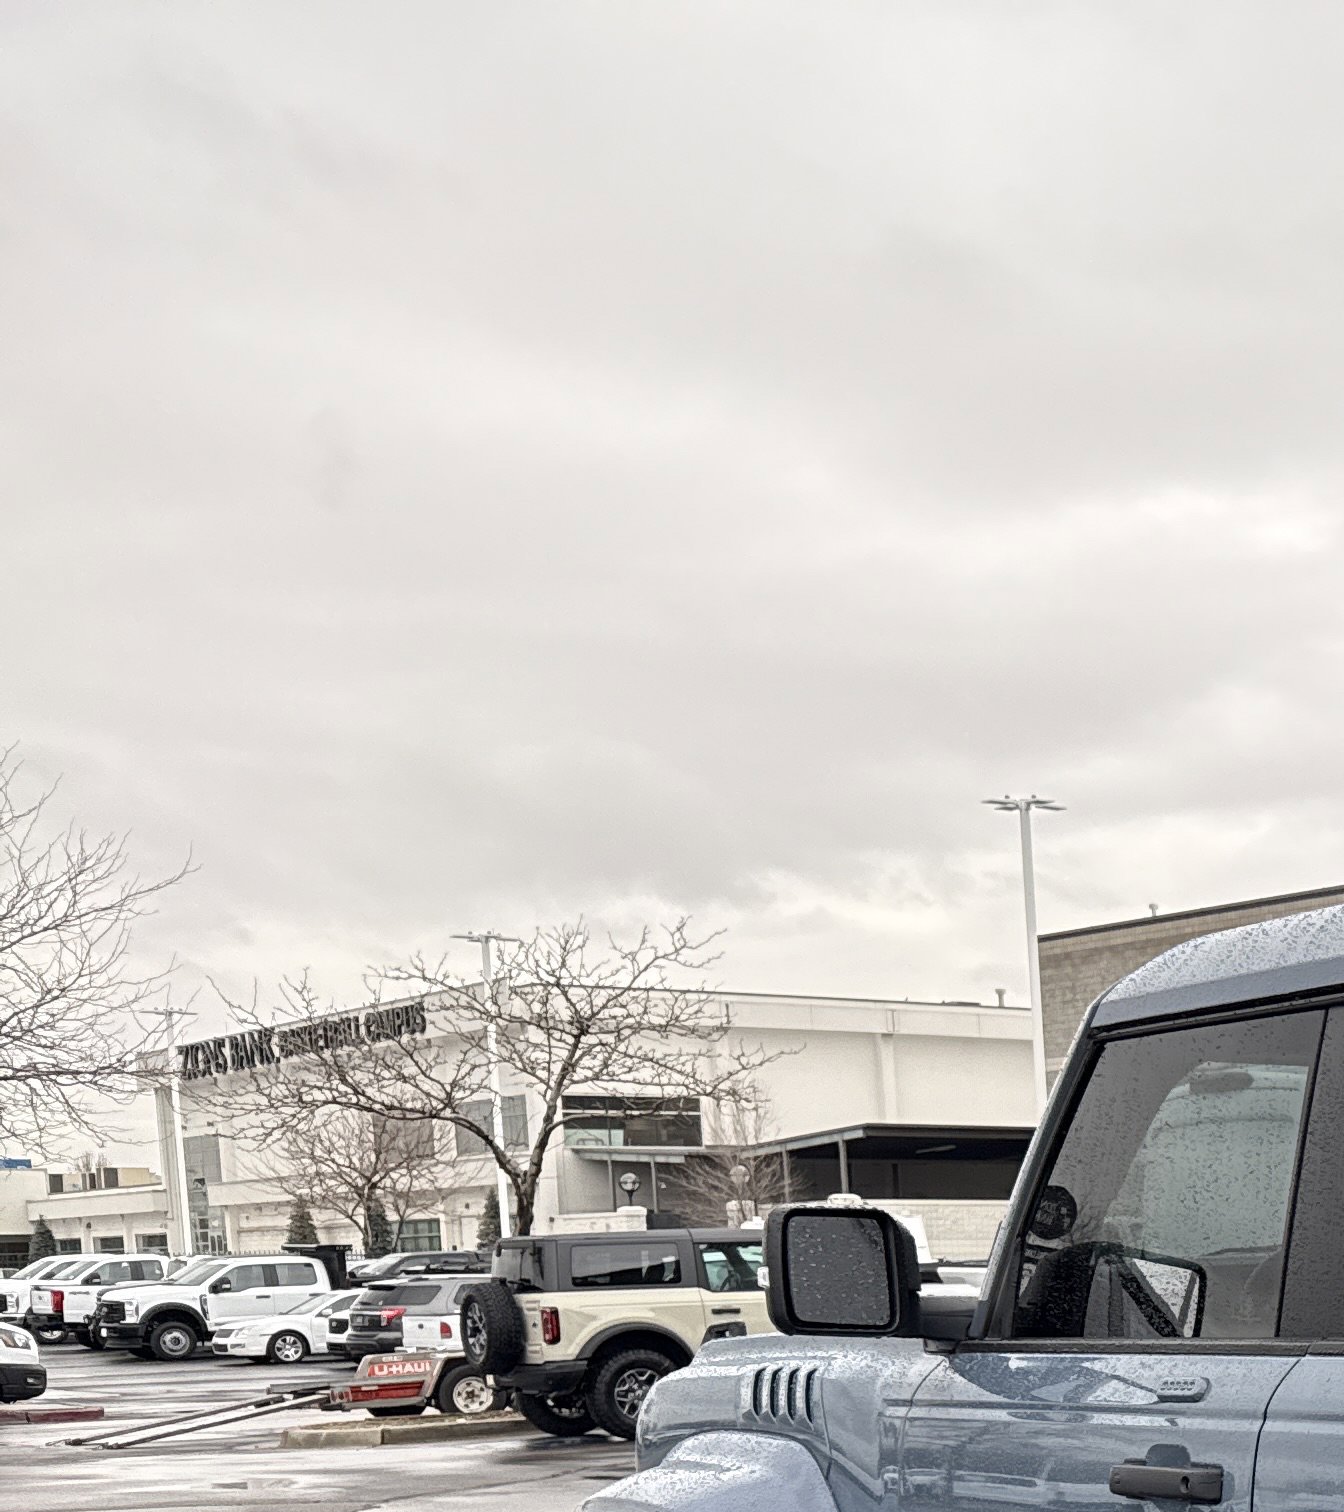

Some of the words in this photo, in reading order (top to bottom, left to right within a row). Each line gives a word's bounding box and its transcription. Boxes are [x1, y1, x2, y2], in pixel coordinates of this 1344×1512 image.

[176, 1037, 229, 1081] ZIONS
[278, 1014, 364, 1059] BASKETBALL
[364, 1001, 427, 1044] CAMPUS
